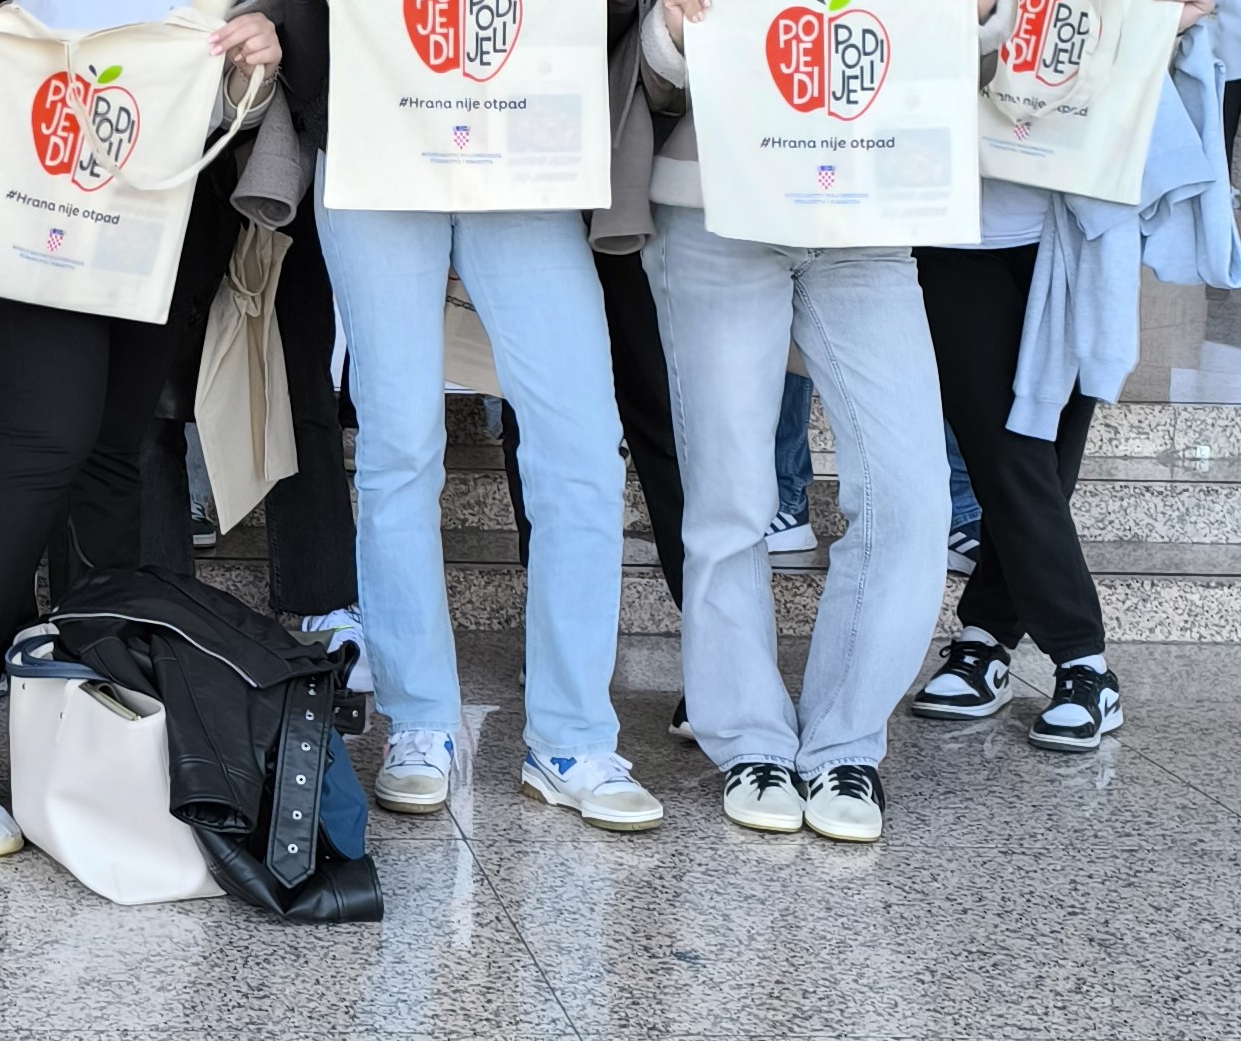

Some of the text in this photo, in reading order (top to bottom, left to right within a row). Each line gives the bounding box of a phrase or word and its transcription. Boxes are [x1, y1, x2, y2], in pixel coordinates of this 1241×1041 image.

[417, 0, 449, 35] JE
[778, 15, 819, 48] PO
[429, 28, 455, 65] DI
[466, 21, 508, 66] JELI
[780, 39, 813, 74] JE
[834, 24, 884, 69] PODI
[793, 66, 819, 104] DI
[832, 60, 875, 105] JELI
[399, 97, 527, 111] #Hrana nije otpad
[1023, 97, 1047, 110] nije
[45, 132, 74, 166] DI
[760, 137, 895, 151] #Hrana nije otpad
[6, 190, 120, 225] #Hrana nije otpad
